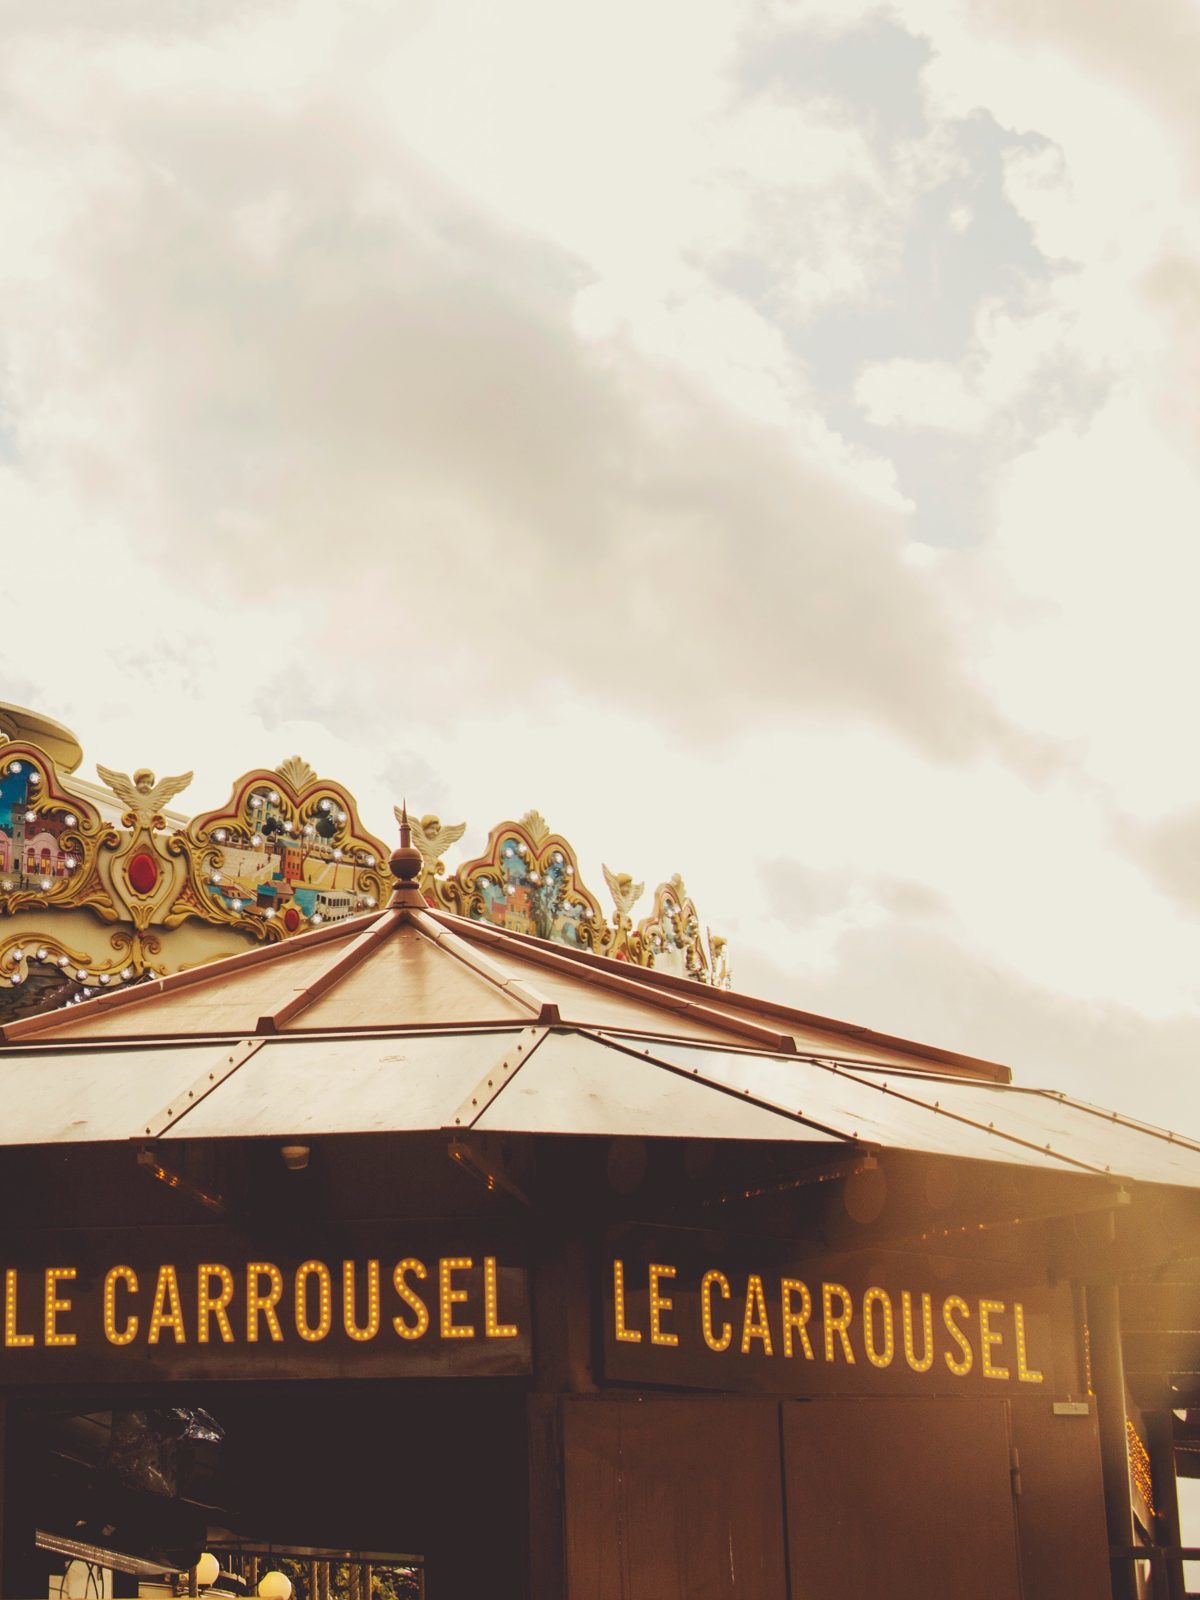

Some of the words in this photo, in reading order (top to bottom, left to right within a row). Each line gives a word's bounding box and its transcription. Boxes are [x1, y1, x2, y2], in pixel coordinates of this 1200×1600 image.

[5, 1267, 77, 1347] LE
[103, 1256, 518, 1346] CARROUSEL
[613, 1259, 679, 1347] LE
[701, 1269, 1044, 1383] CARROUSEL
